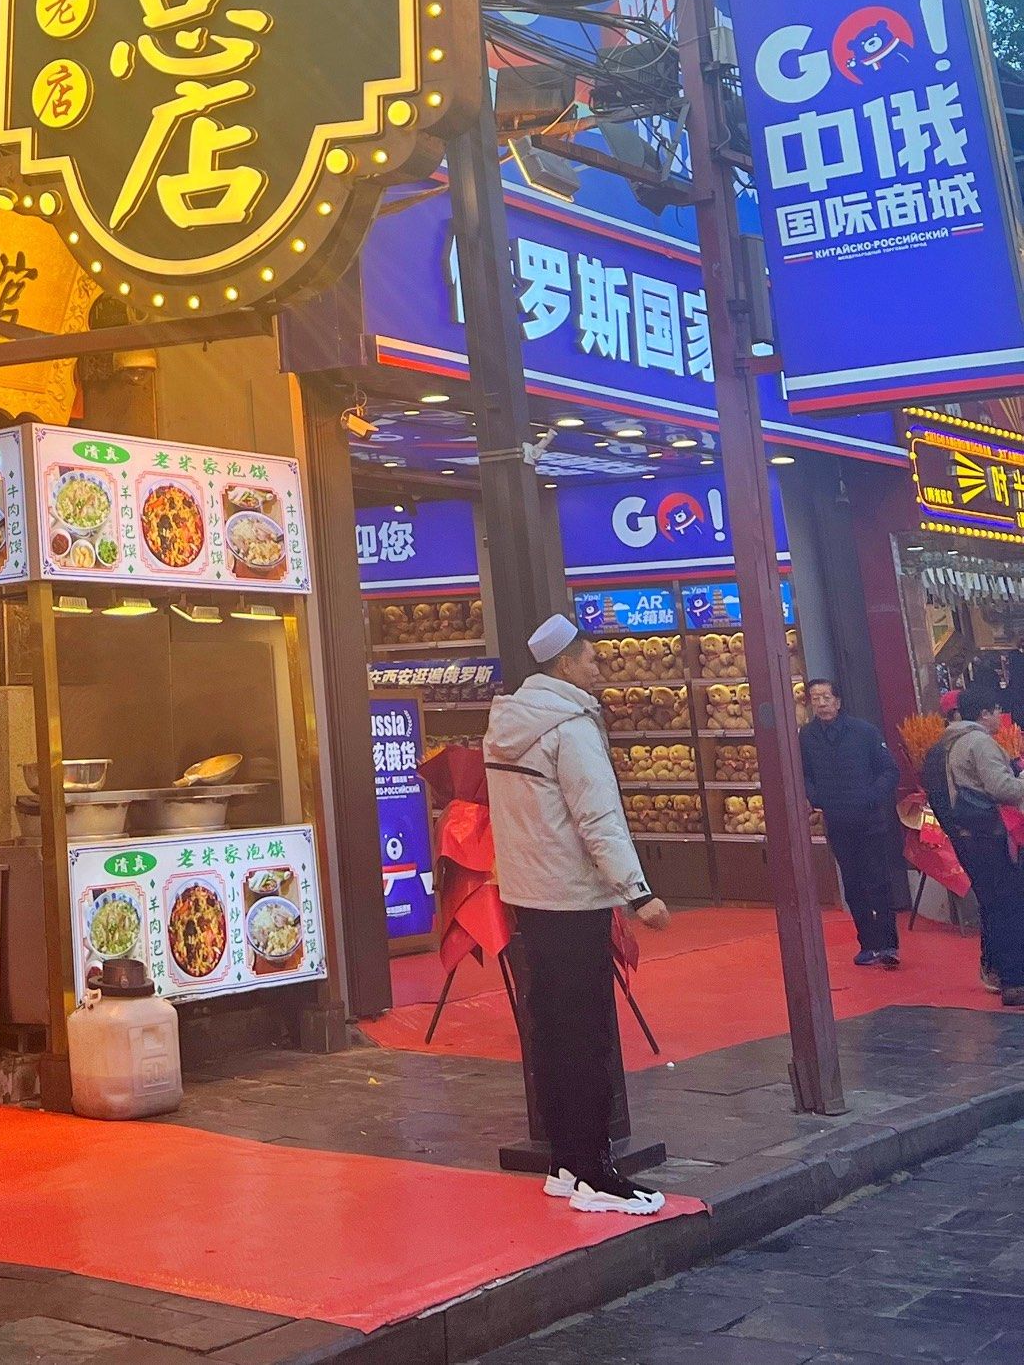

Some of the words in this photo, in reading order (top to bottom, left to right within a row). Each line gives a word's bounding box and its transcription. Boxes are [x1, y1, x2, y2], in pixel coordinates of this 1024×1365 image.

[764, 81, 970, 194] 中俄
[775, 173, 982, 248] 国际商城
[83, 444, 121, 464] 清真
[151, 450, 270, 483] 老米家泡馍
[7, 483, 24, 557] 牛肉泡馍
[119, 487, 137, 560] 羊肉泡馍
[204, 493, 224, 566] 小炒泡馍
[285, 503, 304, 573] 牛肉泡馍
[627, 608, 674, 625] 冰箱贴
[636, 594, 663, 610] AR
[113, 855, 148, 873] 清真
[176, 840, 287, 869] 老米家泡馍
[148, 895, 167, 980] 羊肉泡馍
[227, 887, 245, 966] 小炒泡馍
[300, 879, 318, 955] 牛肉泡馍
